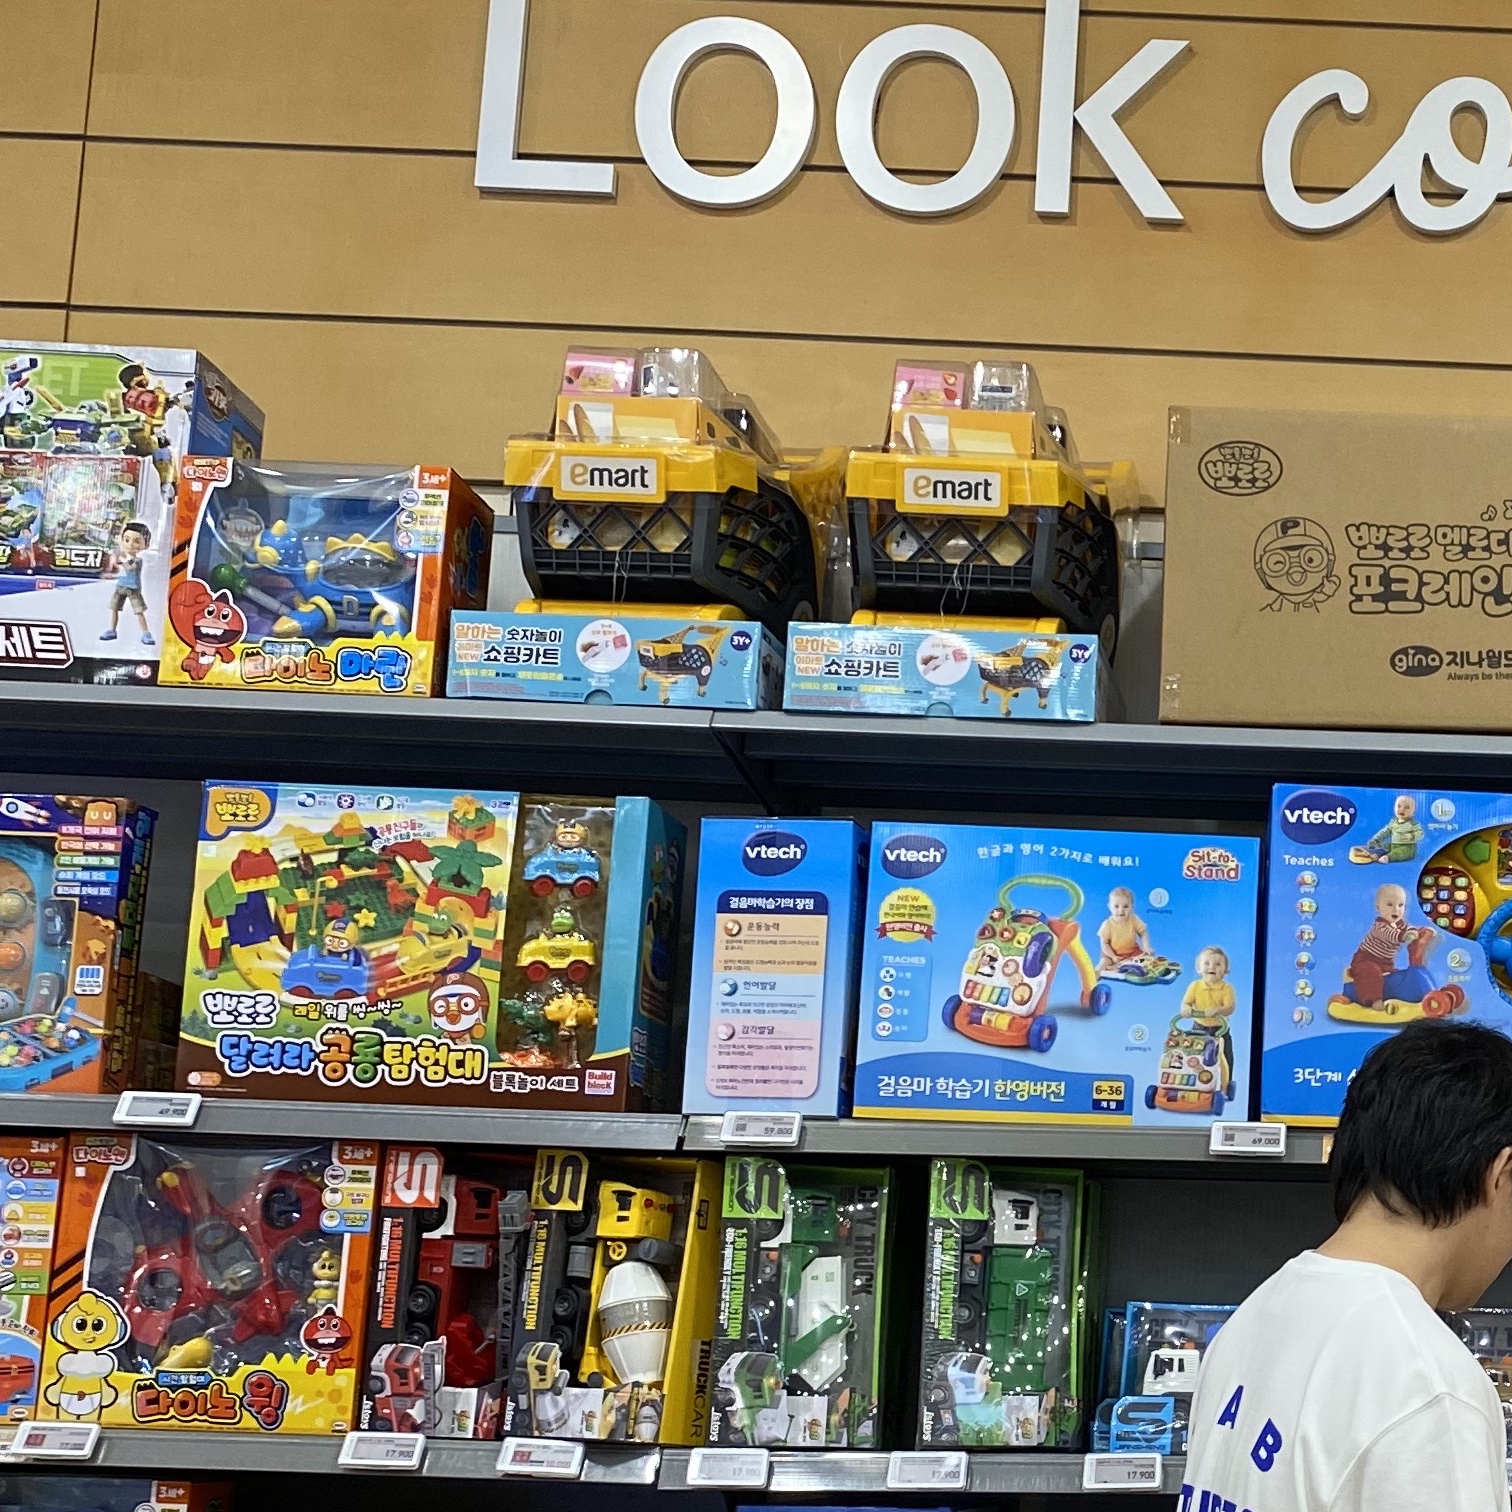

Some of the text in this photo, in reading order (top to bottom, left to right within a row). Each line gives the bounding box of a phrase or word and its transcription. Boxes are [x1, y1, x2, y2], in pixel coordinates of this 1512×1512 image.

[475, 0, 1190, 226] Look
[569, 462, 649, 489] emart
[912, 474, 993, 502] emart
[1345, 523, 1433, 560] 뽀로로
[506, 626, 562, 643] 숫자놀이
[482, 643, 560, 666] 쇼핑카트
[823, 656, 901, 679] 쇼핑카트
[1447, 671, 1479, 683] Always
[1482, 671, 1494, 680] be
[1283, 806, 1351, 826] vtech
[745, 844, 803, 860] vtech
[884, 847, 942, 863] vtech
[1283, 854, 1335, 867] Teaches
[1184, 863, 1240, 880] Stand
[794, 896, 814, 910] 장점
[896, 894, 920, 903] NEW
[882, 955, 926, 965] TEACHES
[202, 992, 277, 1024] 뽀로로
[219, 1034, 315, 1073] 달려라
[489, 1071, 579, 1091] 블록놀이 세트
[1293, 1066, 1343, 1086] 3단계
[877, 1076, 1066, 1102] 걸음마 학습기 한영버전
[1094, 1084, 1123, 1096] 6-36
[852, 1233, 877, 1297] TRUCK
[134, 1370, 289, 1430] 다이노 윙
